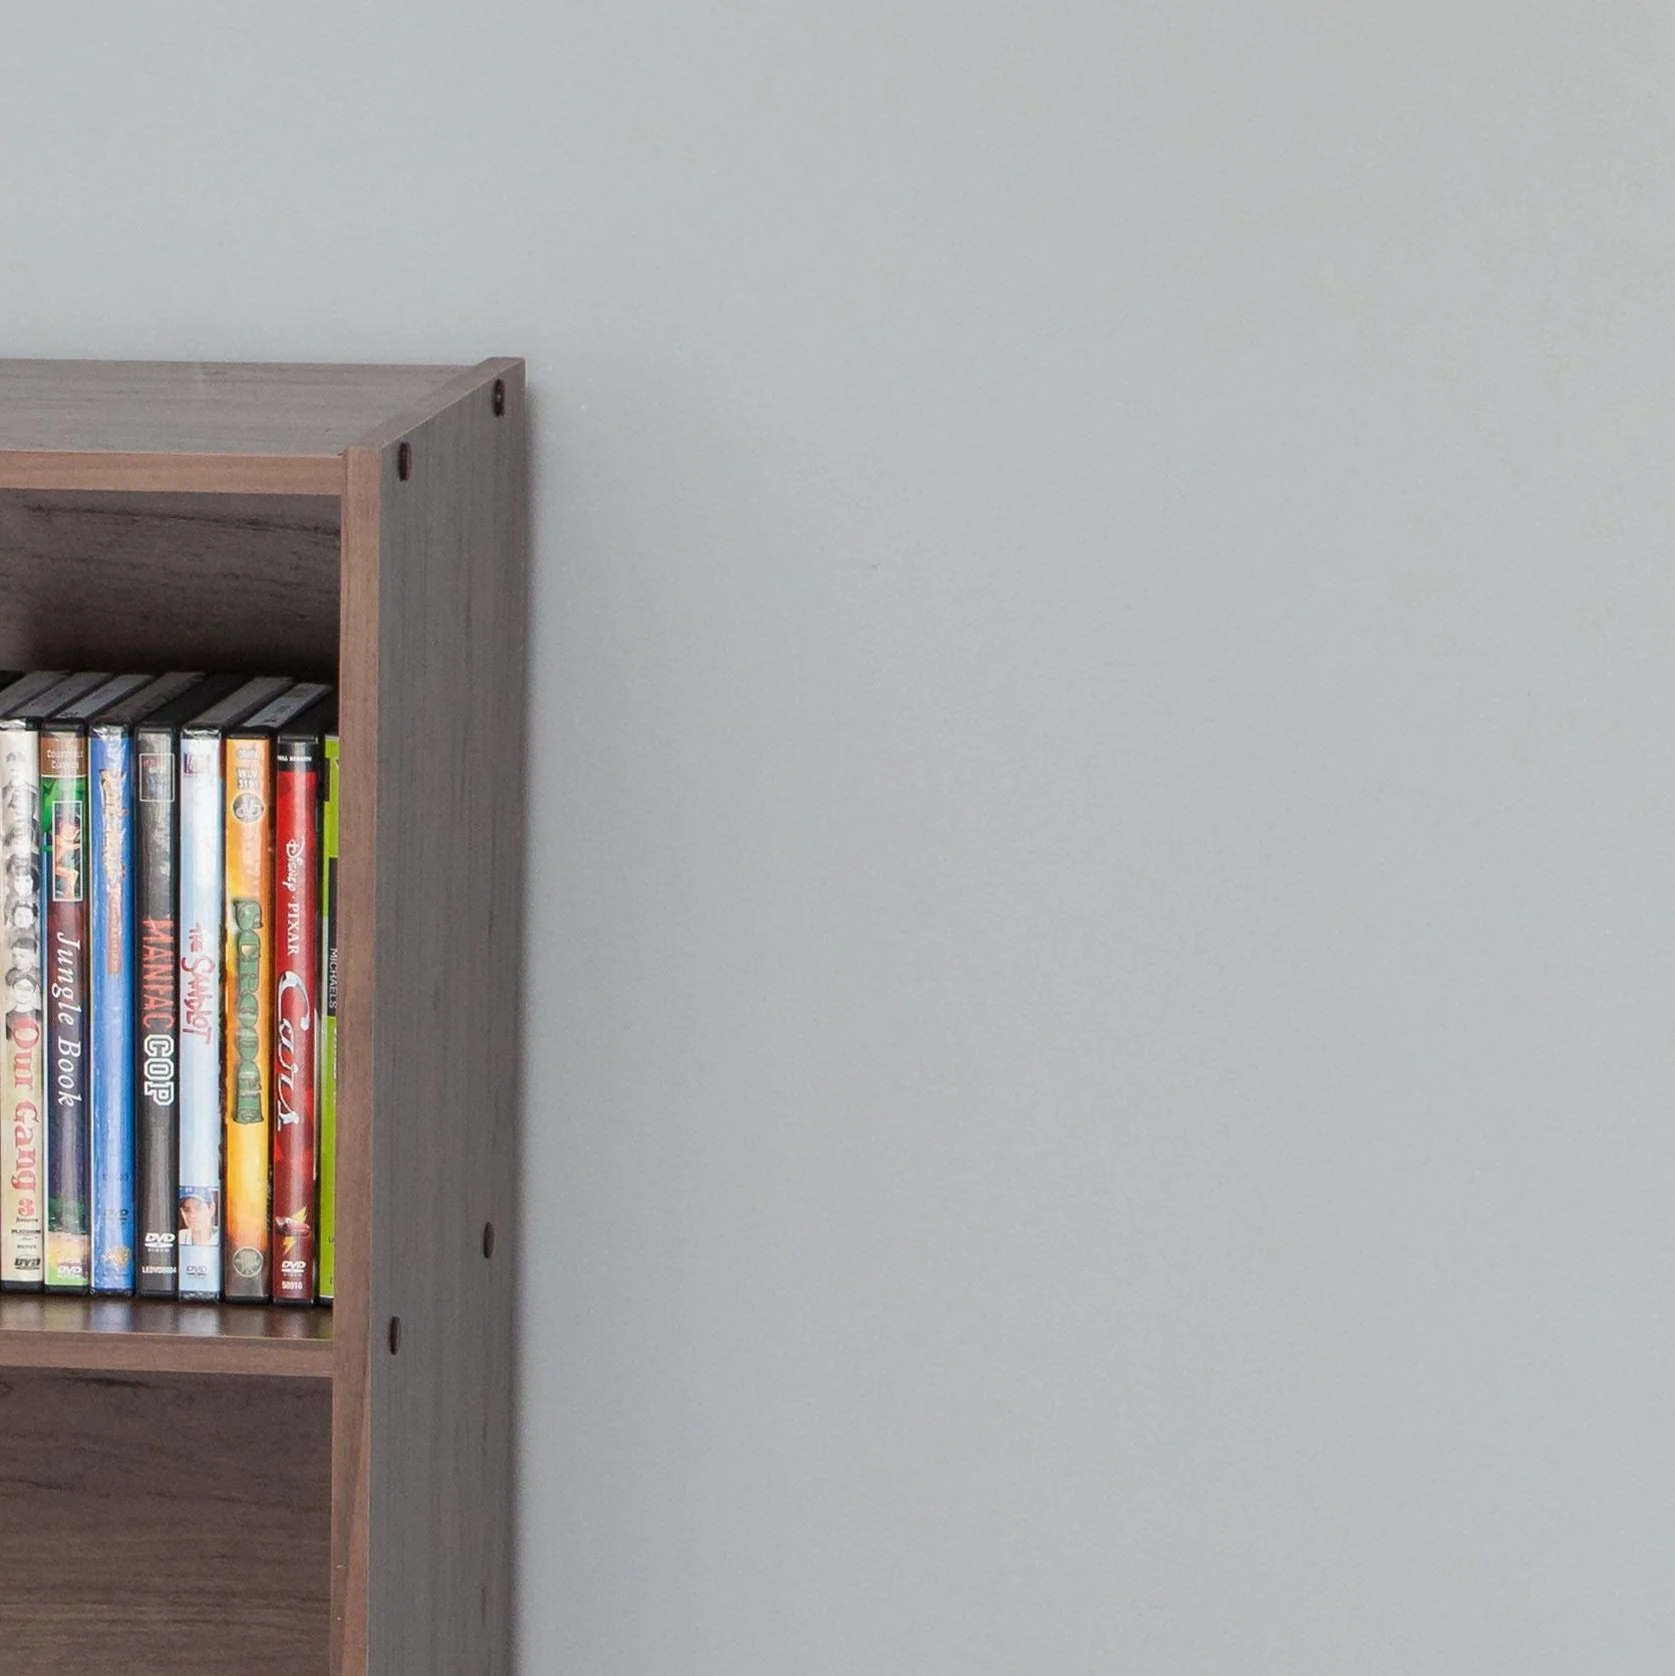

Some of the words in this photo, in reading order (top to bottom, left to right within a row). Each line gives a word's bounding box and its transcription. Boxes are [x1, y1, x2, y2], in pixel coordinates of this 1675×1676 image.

[282, 835, 306, 891] Disney
[287, 902, 300, 956] PIXAR
[51, 931, 82, 1026] Jungle
[142, 917, 175, 1028] MANIAC
[12, 1017, 39, 1091] Our
[57, 1036, 83, 1107] Book
[144, 1034, 175, 1106] COP
[277, 969, 311, 1132] Cars
[11, 1099, 39, 1192] Gang
[145, 1232, 176, 1242] DVD
[281, 1260, 307, 1269] DVD
